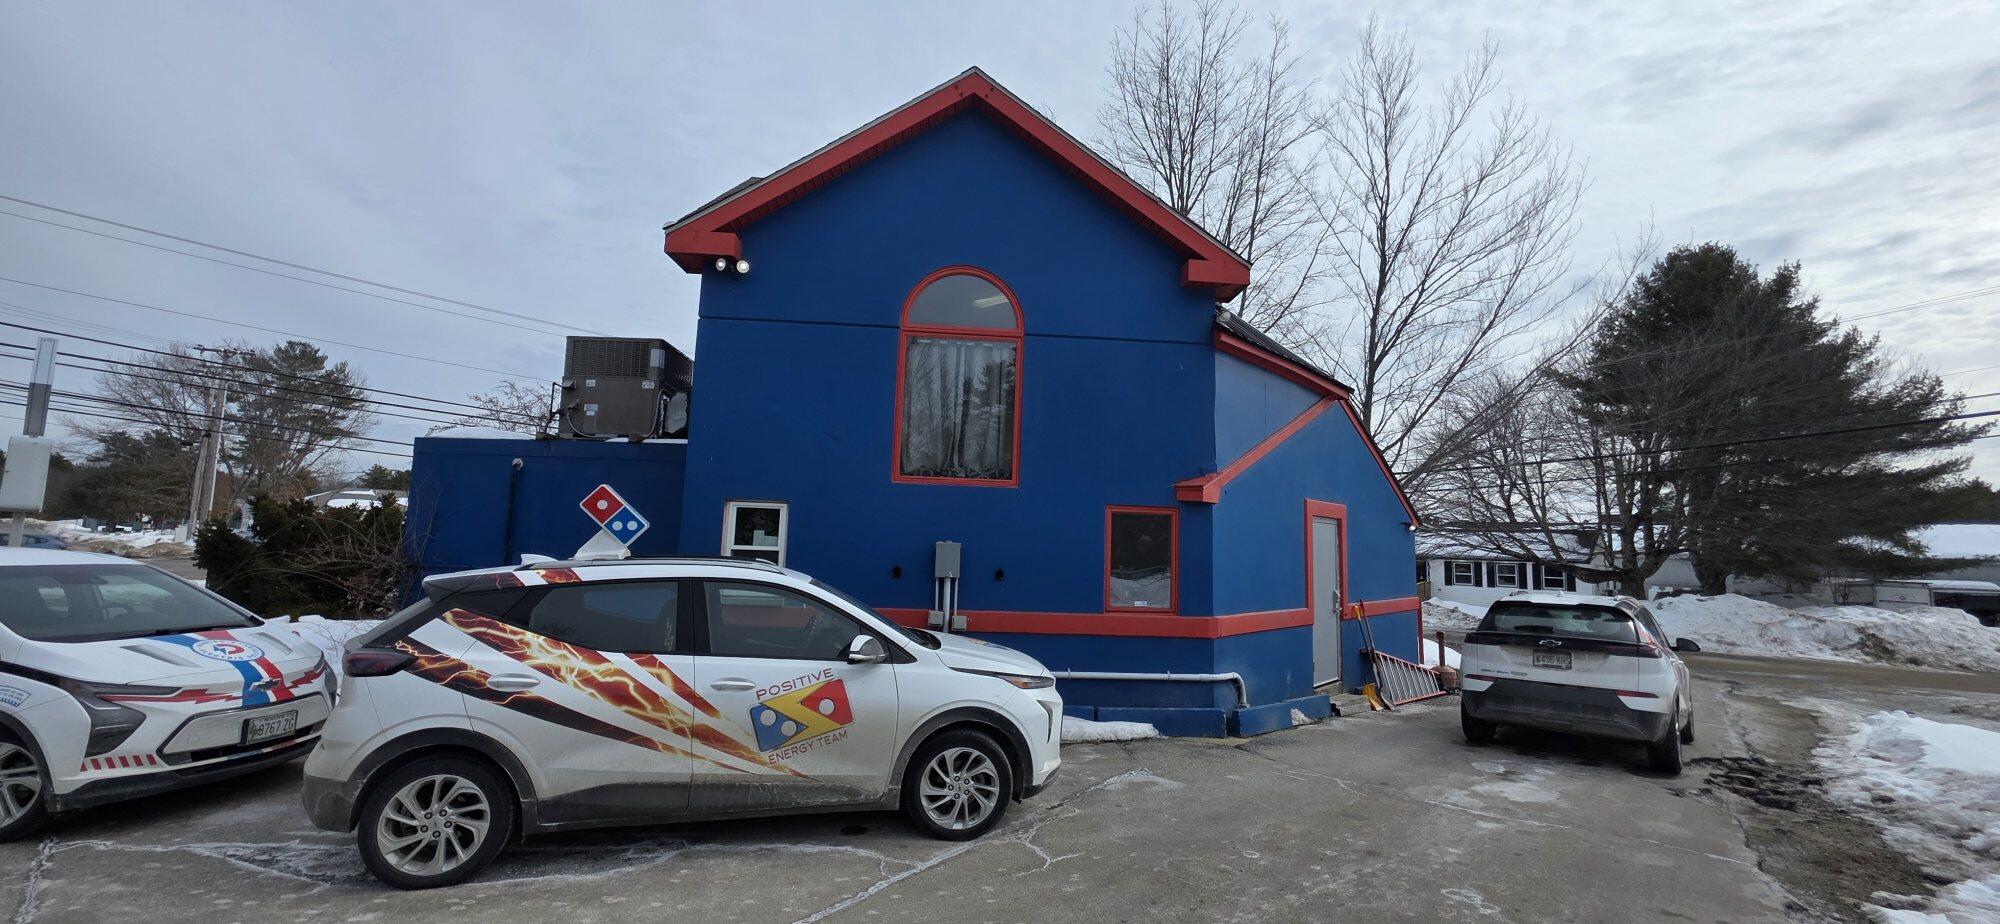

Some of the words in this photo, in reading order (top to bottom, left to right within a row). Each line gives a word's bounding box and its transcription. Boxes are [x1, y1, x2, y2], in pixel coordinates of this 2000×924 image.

[756, 668, 834, 700] POSITIVE
[768, 740, 815, 765] ENERGY
[817, 730, 848, 746] TEAM
